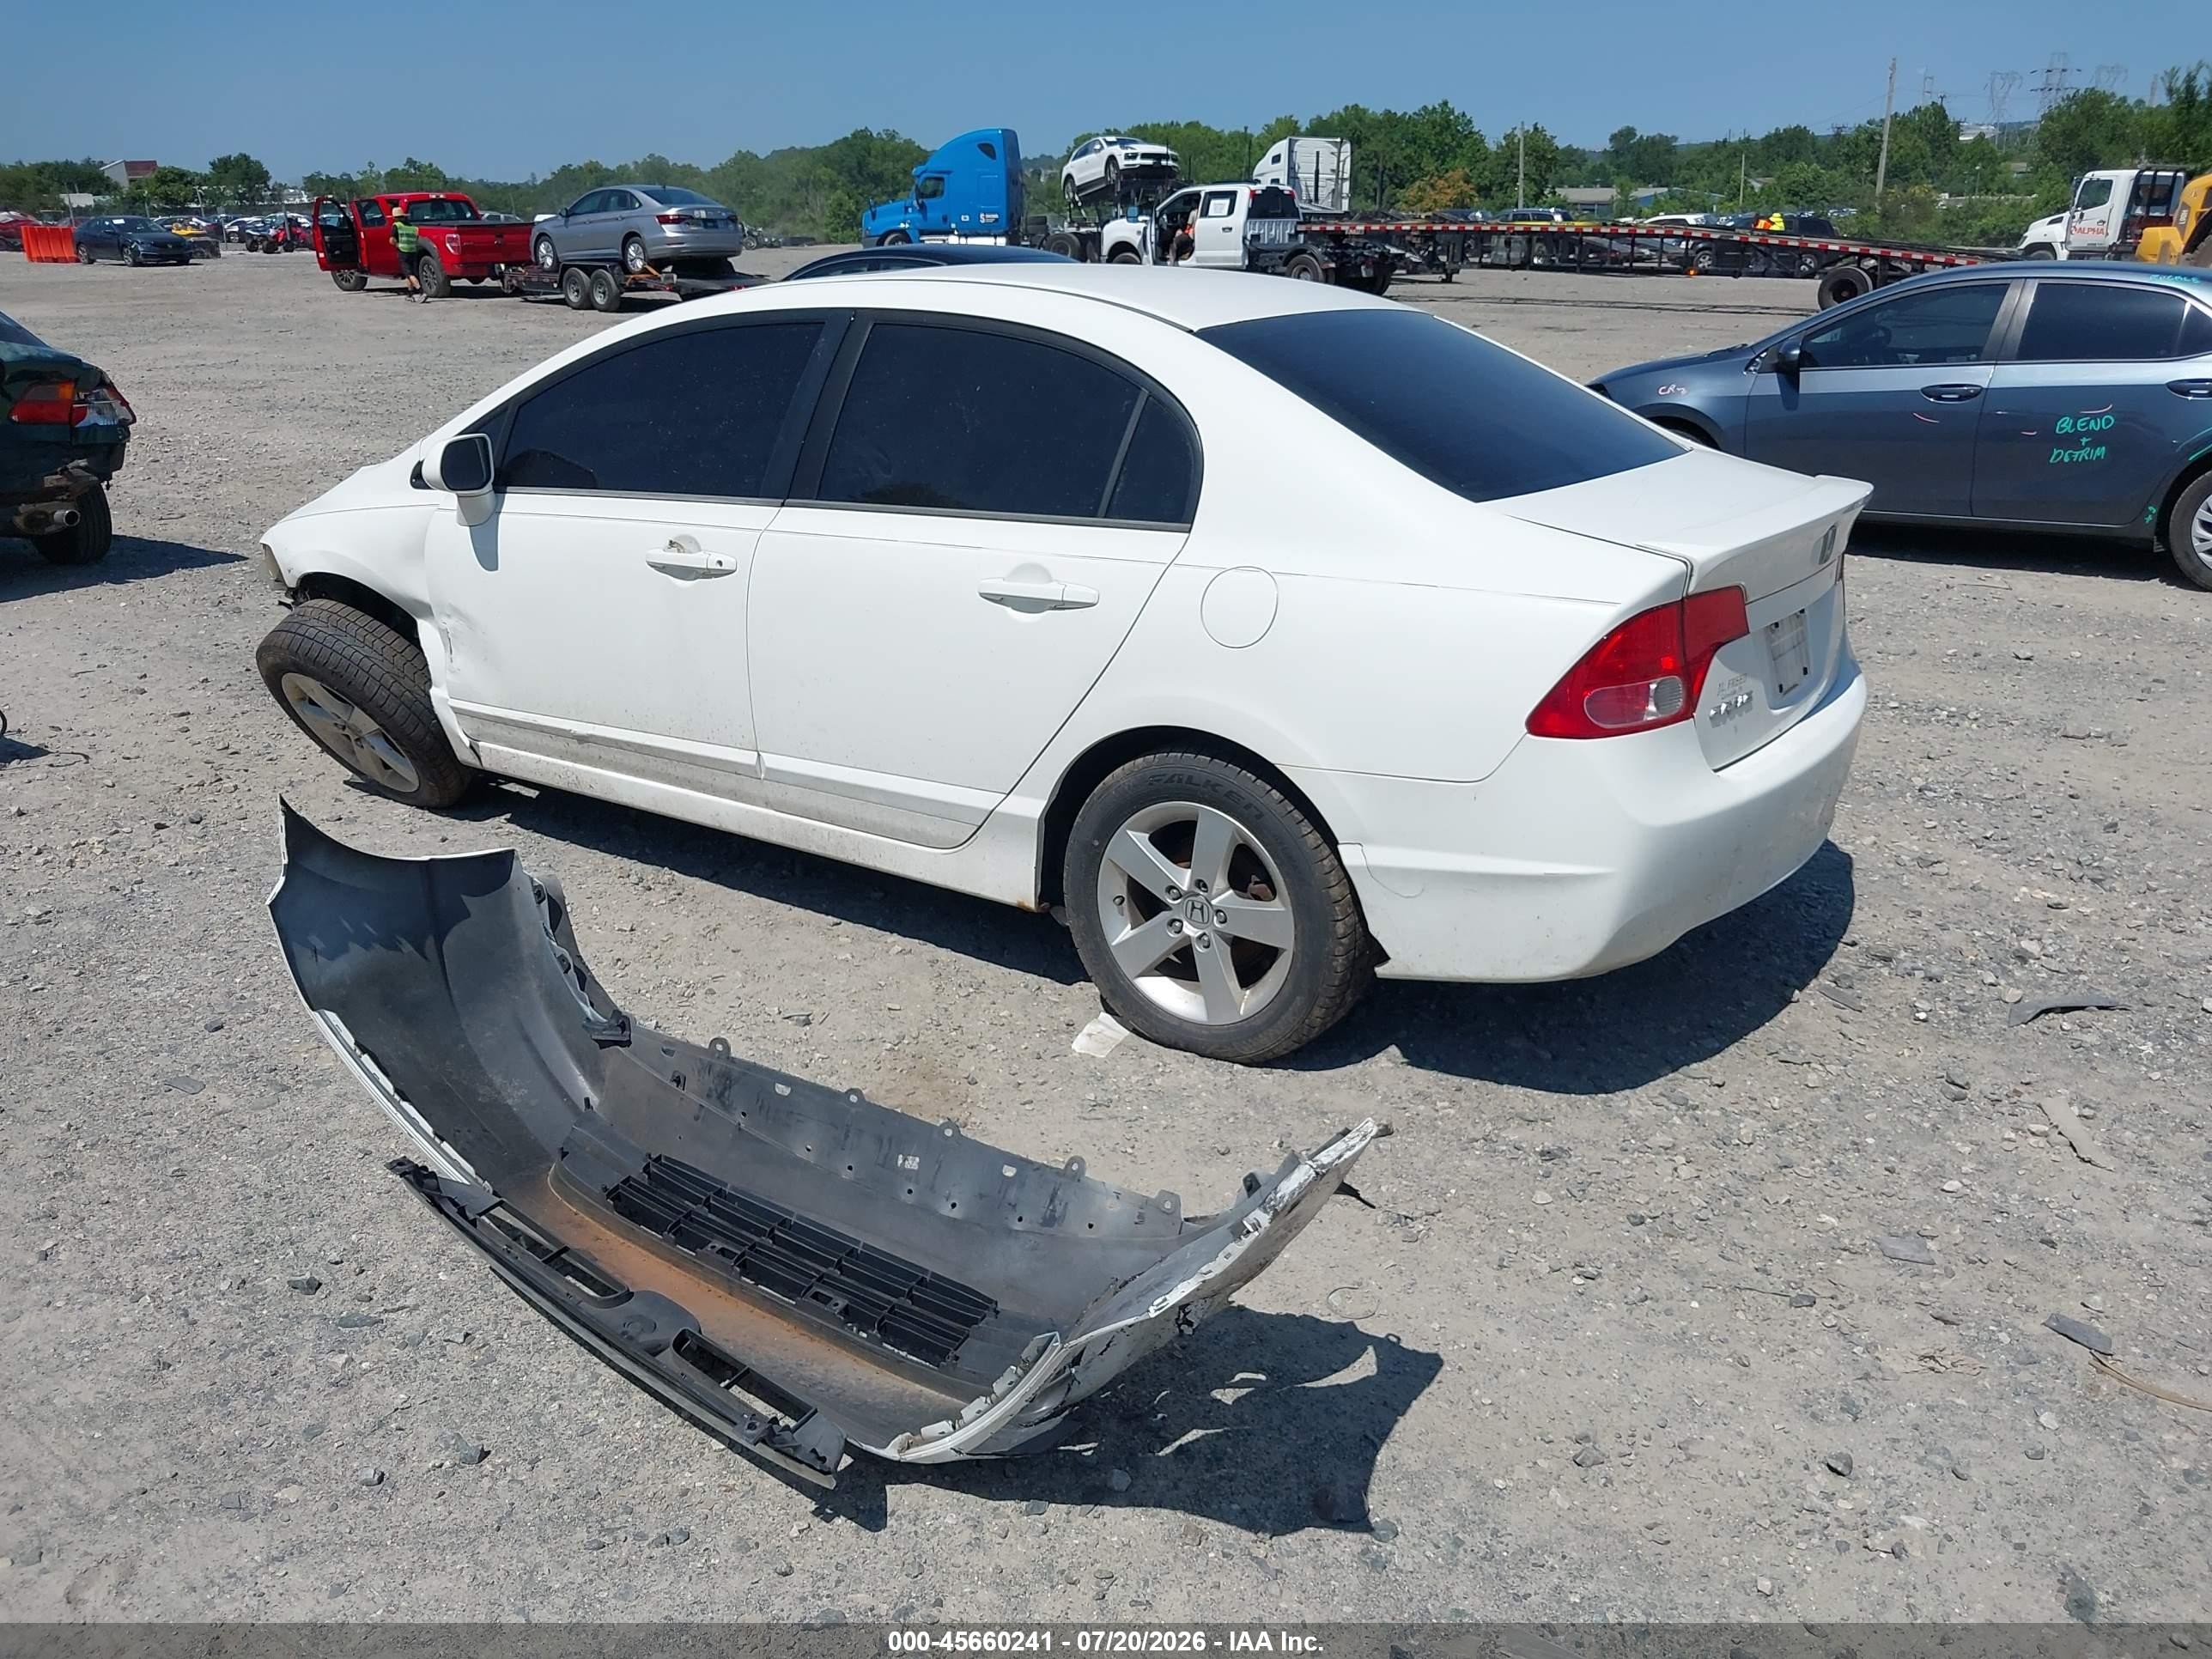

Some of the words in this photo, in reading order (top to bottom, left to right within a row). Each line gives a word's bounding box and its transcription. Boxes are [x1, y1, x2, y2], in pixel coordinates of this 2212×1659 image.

[2077, 227, 2105, 235] ALPHA
[2055, 415, 2115, 434] BLEND
[2049, 446, 2106, 463] DETRIM
[1147, 773, 1264, 821] FALKEN
